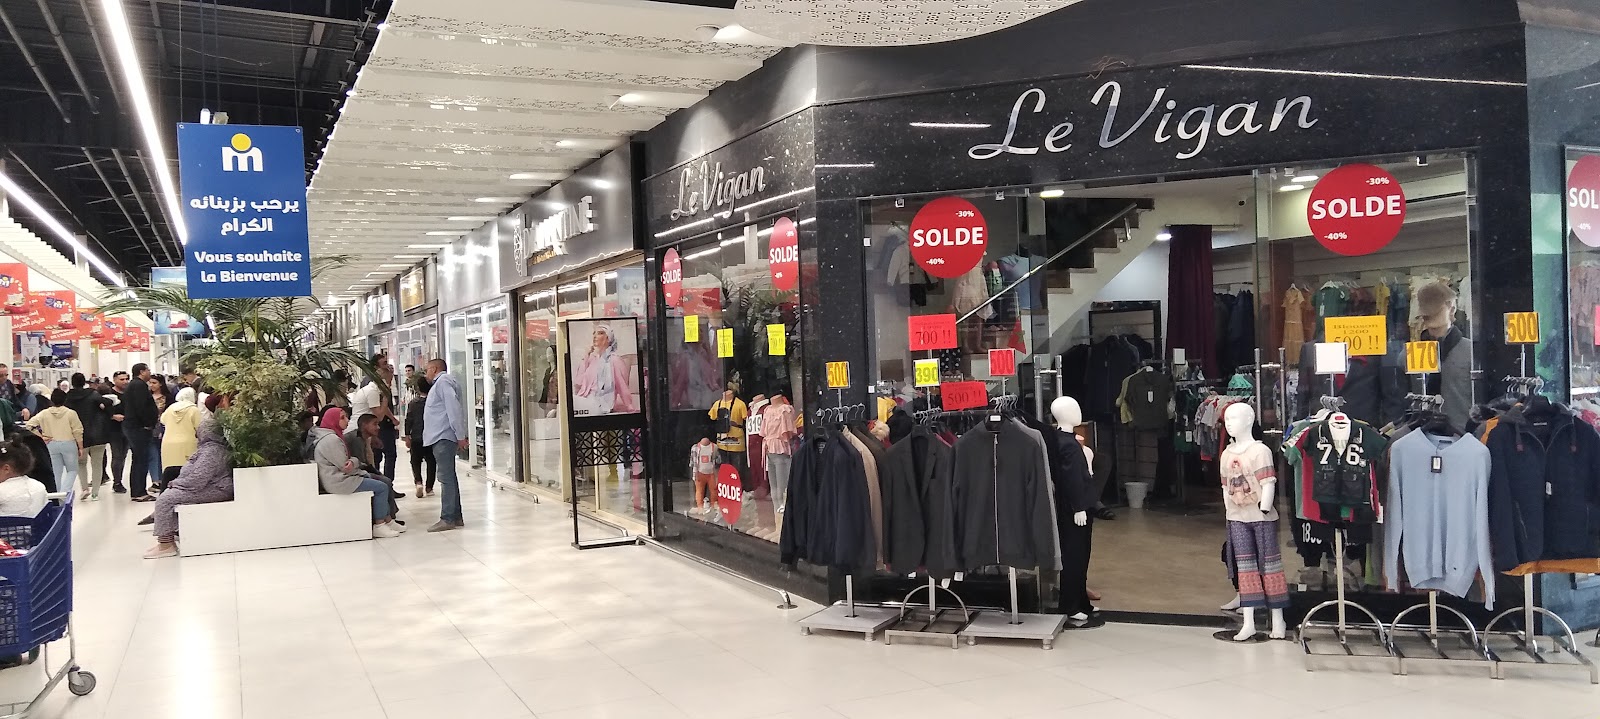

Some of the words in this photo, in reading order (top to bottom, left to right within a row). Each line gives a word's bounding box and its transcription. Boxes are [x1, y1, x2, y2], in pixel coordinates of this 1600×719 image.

[968, 88, 1074, 160] Le
[1090, 81, 1319, 160] Vigan
[1365, 177, 1390, 185] -30%
[670, 168, 699, 221] Le
[699, 161, 766, 219] Vigan
[1569, 187, 1600, 209] SOL
[190, 195, 246, 213] بزبنائه
[250, 198, 300, 214] يرحب
[1312, 194, 1402, 220] SOLDE
[221, 218, 273, 236] الكرام
[912, 226, 984, 247] SOLDE
[1324, 232, 1348, 240] -40%
[194, 251, 234, 263] Vous
[236, 250, 303, 263] souhaite
[769, 244, 799, 265] SOLDE
[925, 257, 945, 265] -40%
[200, 270, 217, 283] la
[219, 270, 299, 283] Bienvenue
[662, 269, 681, 284] SOLDE
[1508, 313, 1538, 342] 500
[915, 330, 938, 345] 700
[1368, 335, 1379, 350] !!
[1407, 342, 1438, 369] 170
[827, 362, 848, 387] 500
[915, 367, 938, 383] 390
[947, 392, 969, 406] 500
[747, 417, 762, 433] 319
[717, 482, 741, 502] SOLDE
